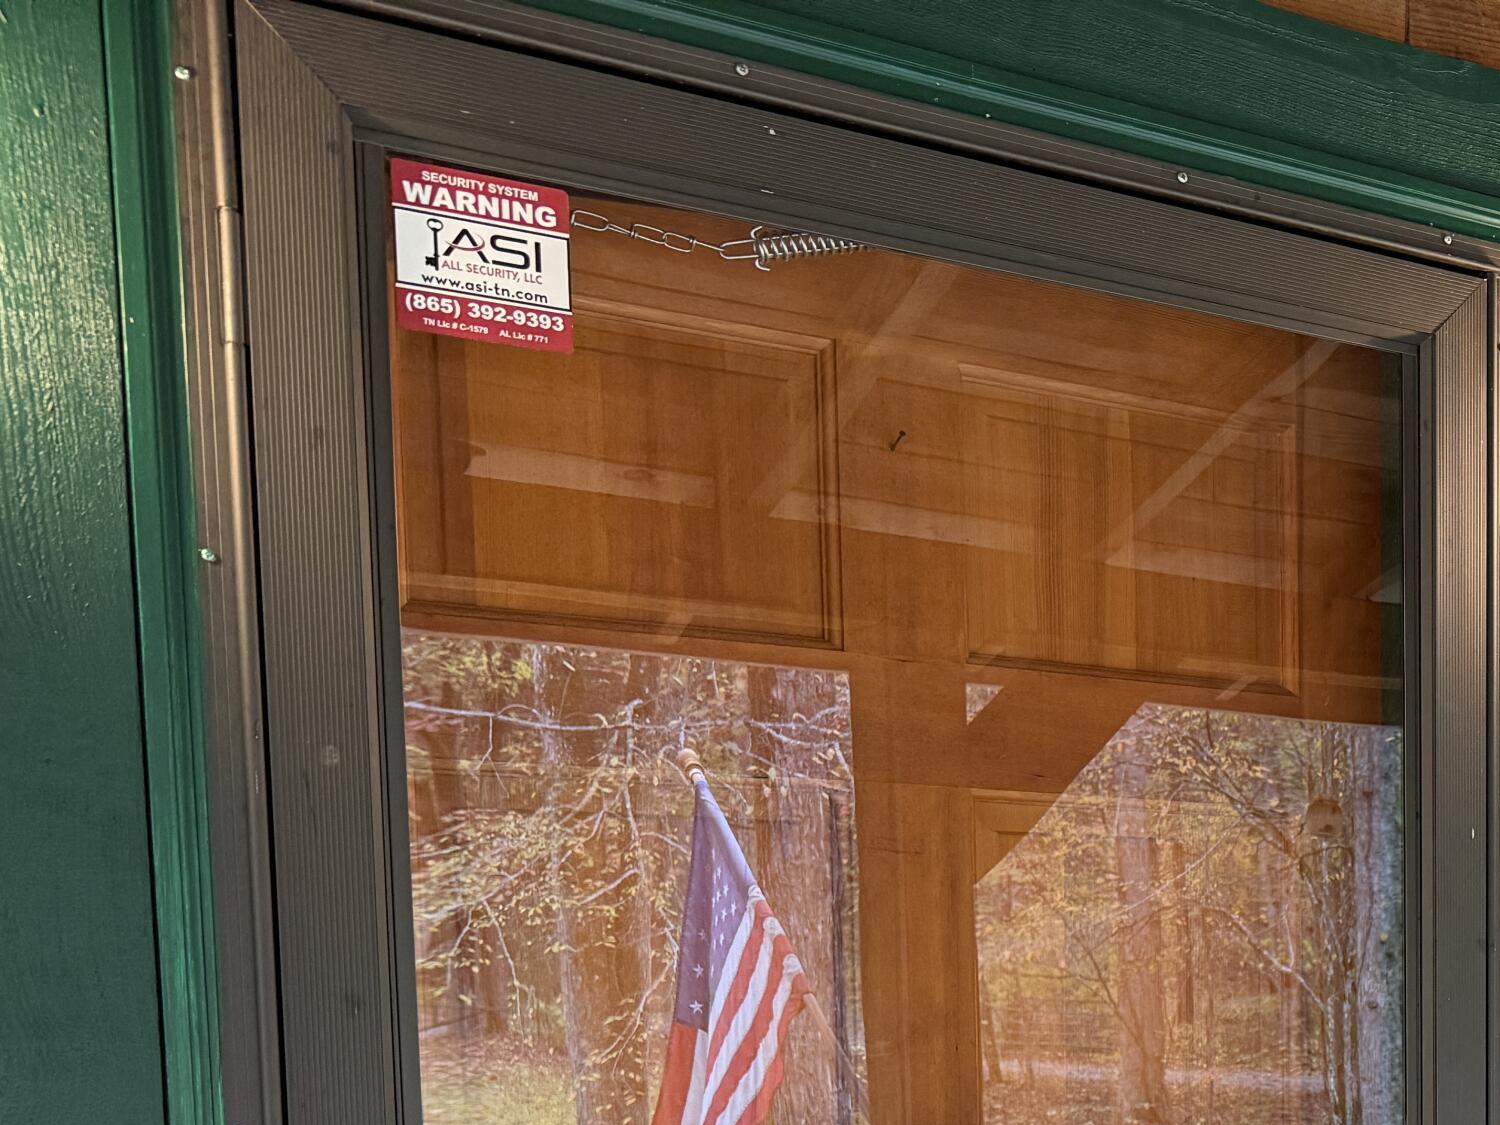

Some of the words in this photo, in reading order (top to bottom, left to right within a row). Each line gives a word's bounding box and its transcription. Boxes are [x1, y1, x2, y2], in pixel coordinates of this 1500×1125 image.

[421, 170, 485, 192] SECURITY
[487, 183, 539, 202] SYSTEM
[402, 180, 557, 228] WARNING
[443, 228, 542, 273] ASI
[441, 260, 463, 271] ALL
[466, 263, 521, 283] SECURITY,
[524, 273, 543, 285] LLC
[421, 273, 548, 304] www.asi-tn.com
[405, 292, 461, 319] (865)
[467, 302, 565, 332] 392-9393
[423, 317, 436, 327] TN
[437, 319, 451, 329] Lic
[499, 329, 512, 338] AL
[513, 331, 526, 341] Lic
[534, 334, 549, 344] 771
